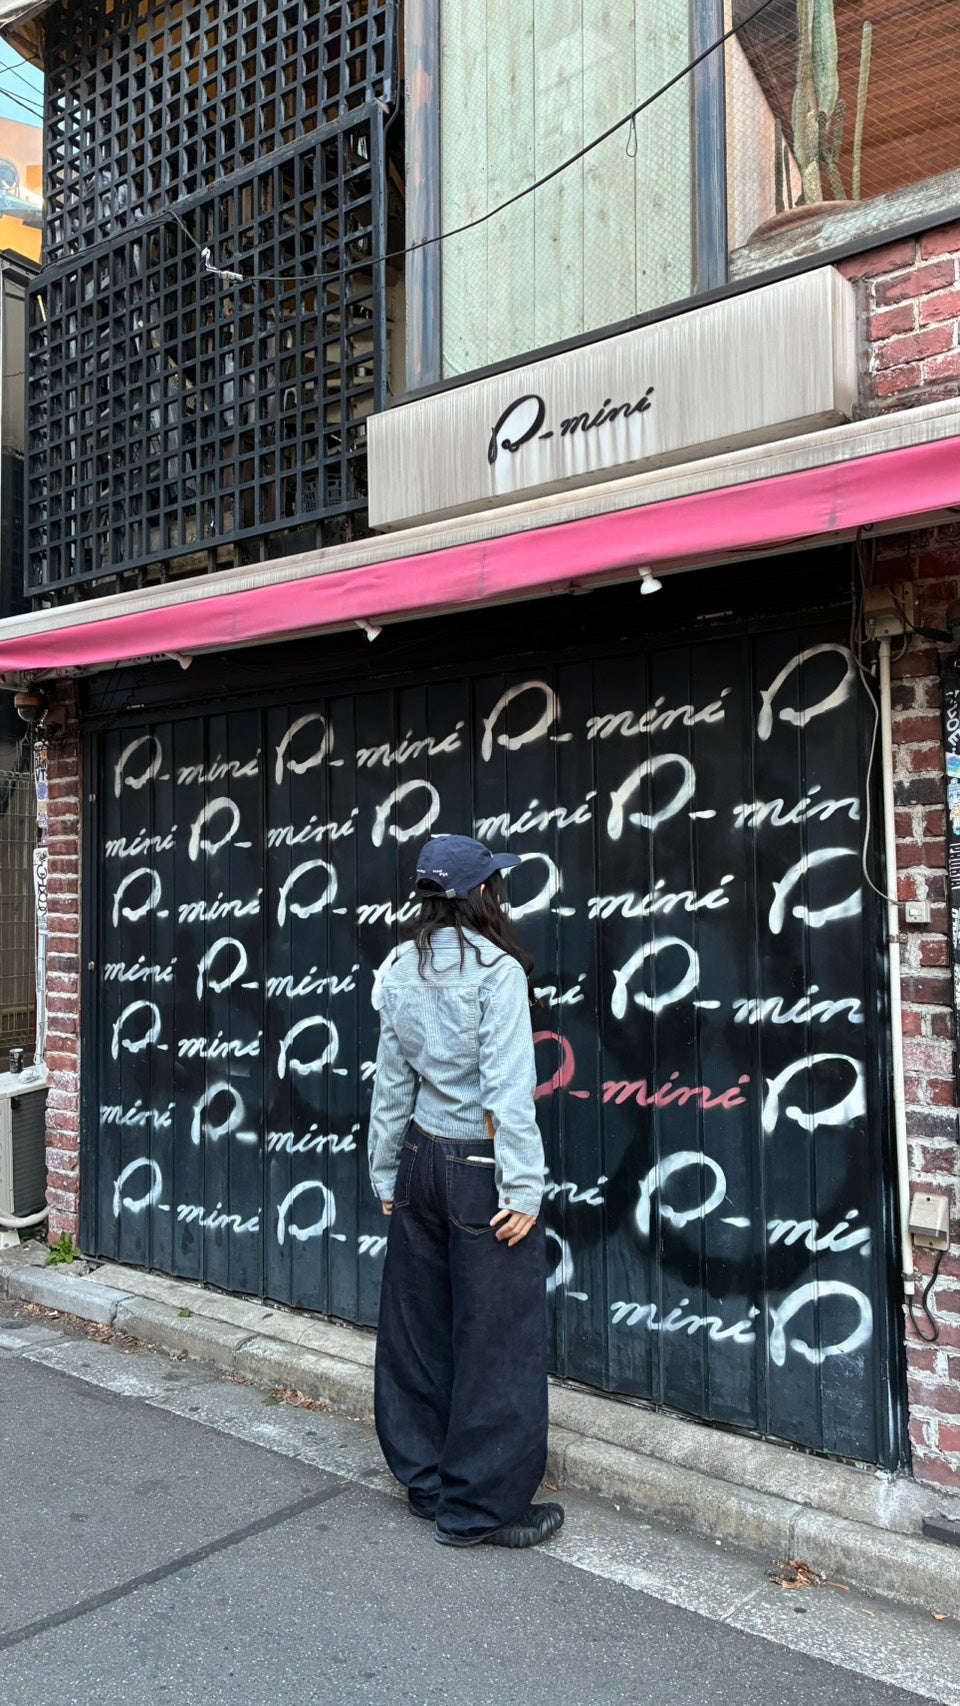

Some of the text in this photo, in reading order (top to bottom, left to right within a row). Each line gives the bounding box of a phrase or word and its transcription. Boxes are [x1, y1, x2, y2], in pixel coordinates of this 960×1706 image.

[487, 387, 654, 465] P-mini
[105, 827, 177, 859] mini
[105, 955, 177, 982] mini
[100, 1101, 175, 1126] mini
